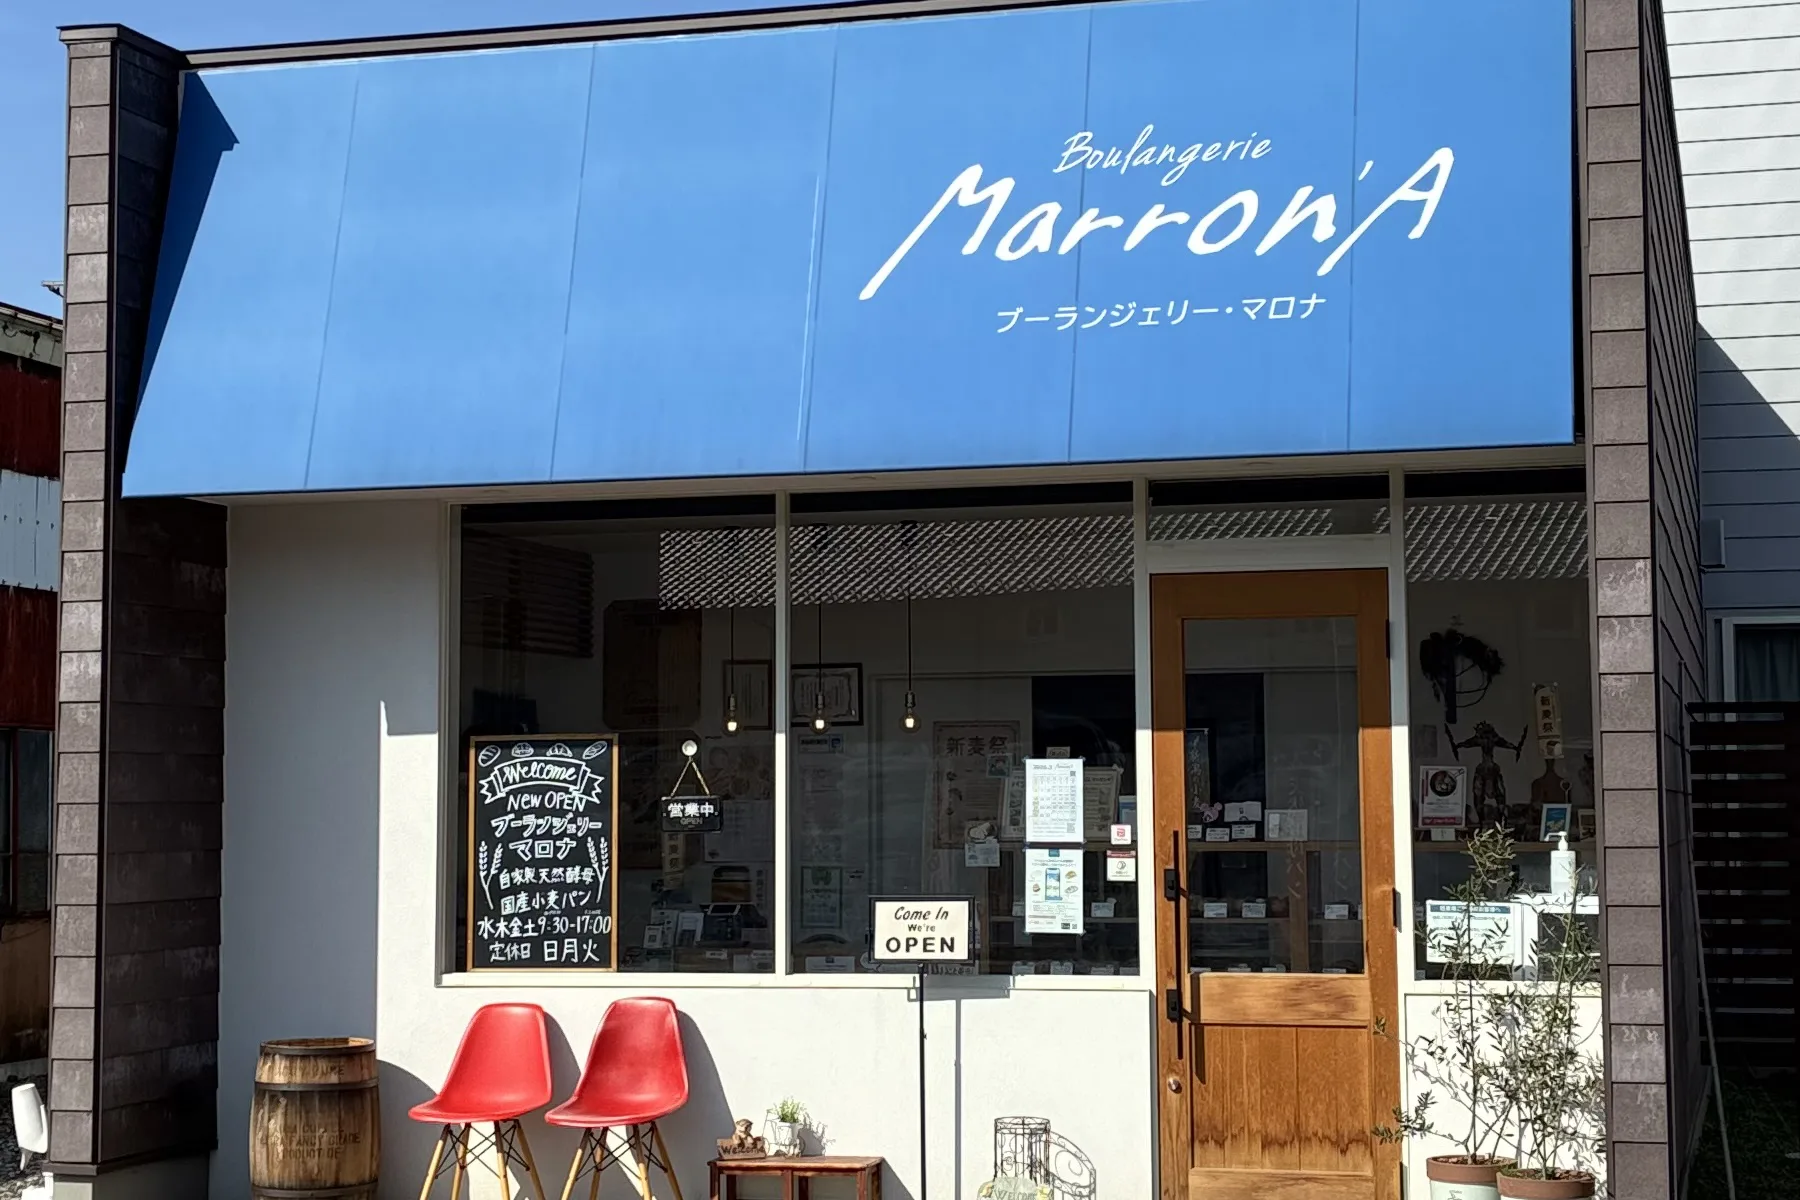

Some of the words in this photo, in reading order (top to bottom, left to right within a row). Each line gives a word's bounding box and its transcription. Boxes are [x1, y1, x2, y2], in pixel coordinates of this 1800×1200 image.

[1053, 124, 1272, 186] Boulangerie
[858, 146, 1455, 302] Marron'A
[996, 293, 1327, 334] ブーランジェリー・マロナ
[946, 735, 1008, 757] 新麦祭
[502, 760, 577, 784] Welcome
[544, 790, 587, 812] OPEN
[668, 801, 715, 819] 営業中
[490, 812, 603, 838] ブーランジェリー
[508, 837, 577, 862] マロナ
[500, 889, 592, 916] 国産小麦パン
[894, 905, 932, 921] Come
[935, 905, 950, 921] In
[907, 922, 936, 933] We're
[489, 940, 532, 963] 定休日
[543, 938, 600, 963] 日月火
[885, 936, 956, 954] OPEN
